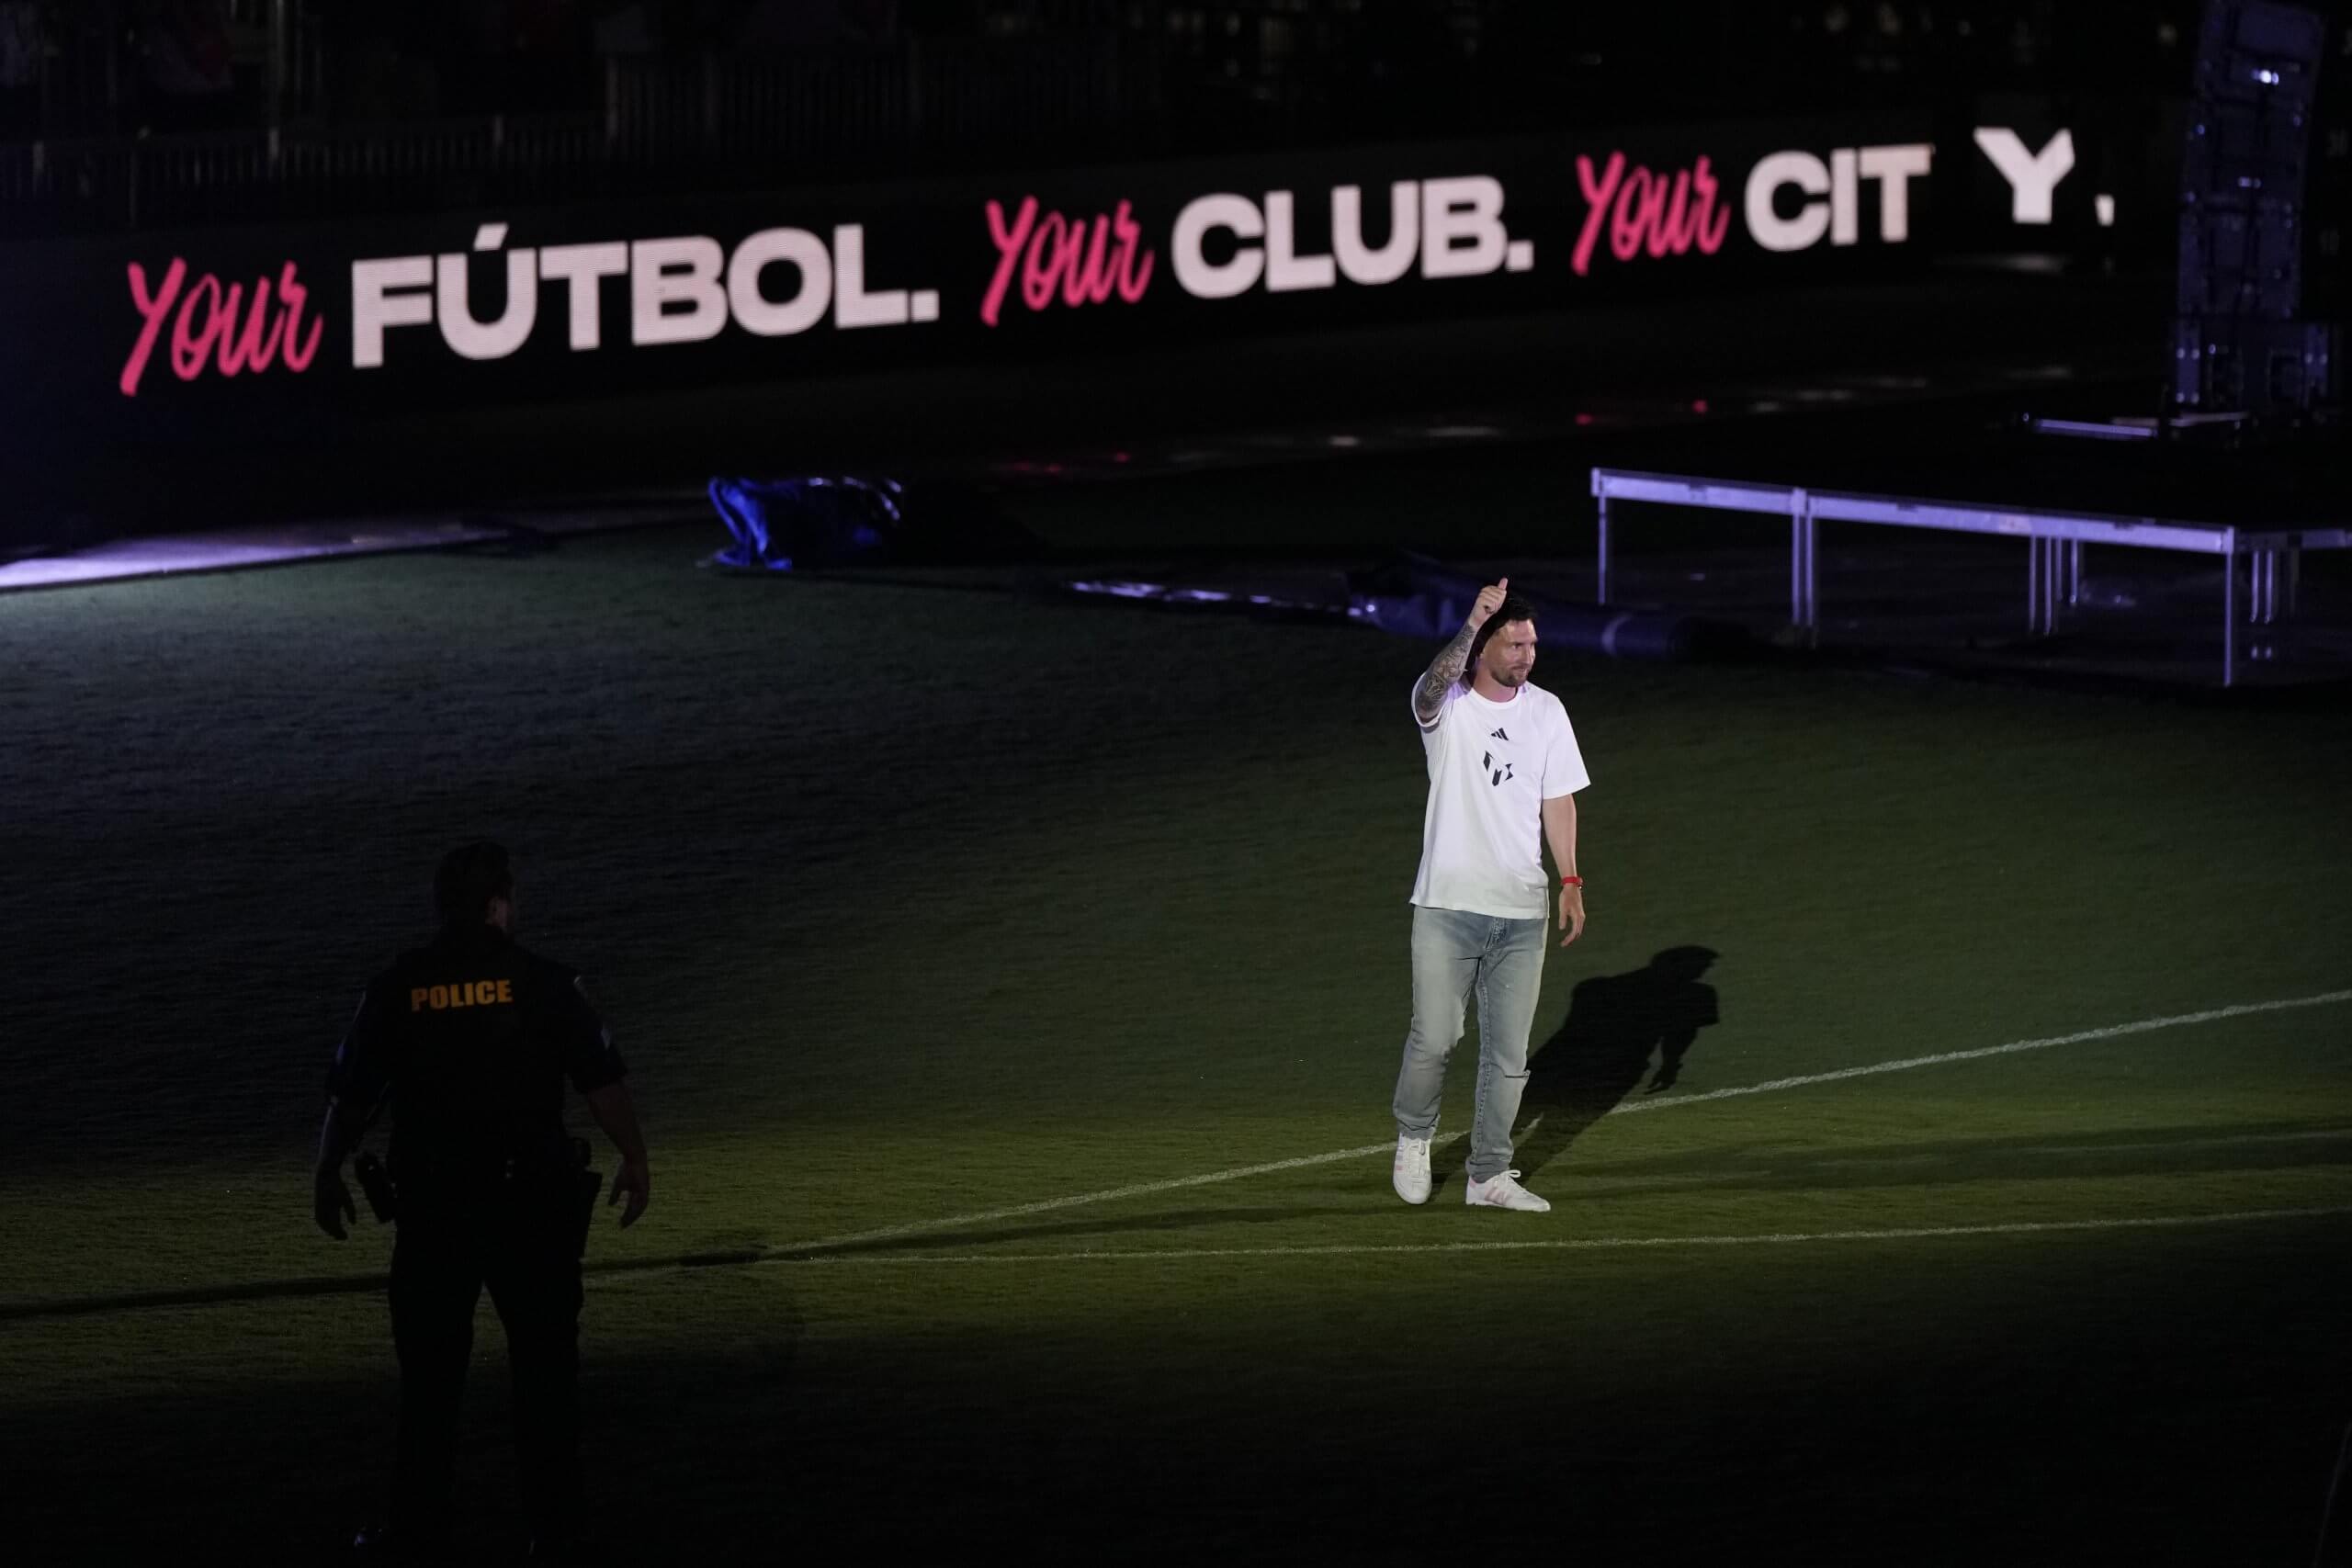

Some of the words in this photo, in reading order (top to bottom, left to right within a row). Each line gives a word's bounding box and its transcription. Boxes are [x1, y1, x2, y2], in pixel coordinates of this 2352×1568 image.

[121, 259, 322, 395] Your
[351, 223, 939, 367] FÚTBOL.
[982, 197, 1152, 324] Your
[1171, 175, 1533, 299] CLUB.
[1573, 153, 1728, 274] Your
[412, 978, 514, 1011] POLICE
